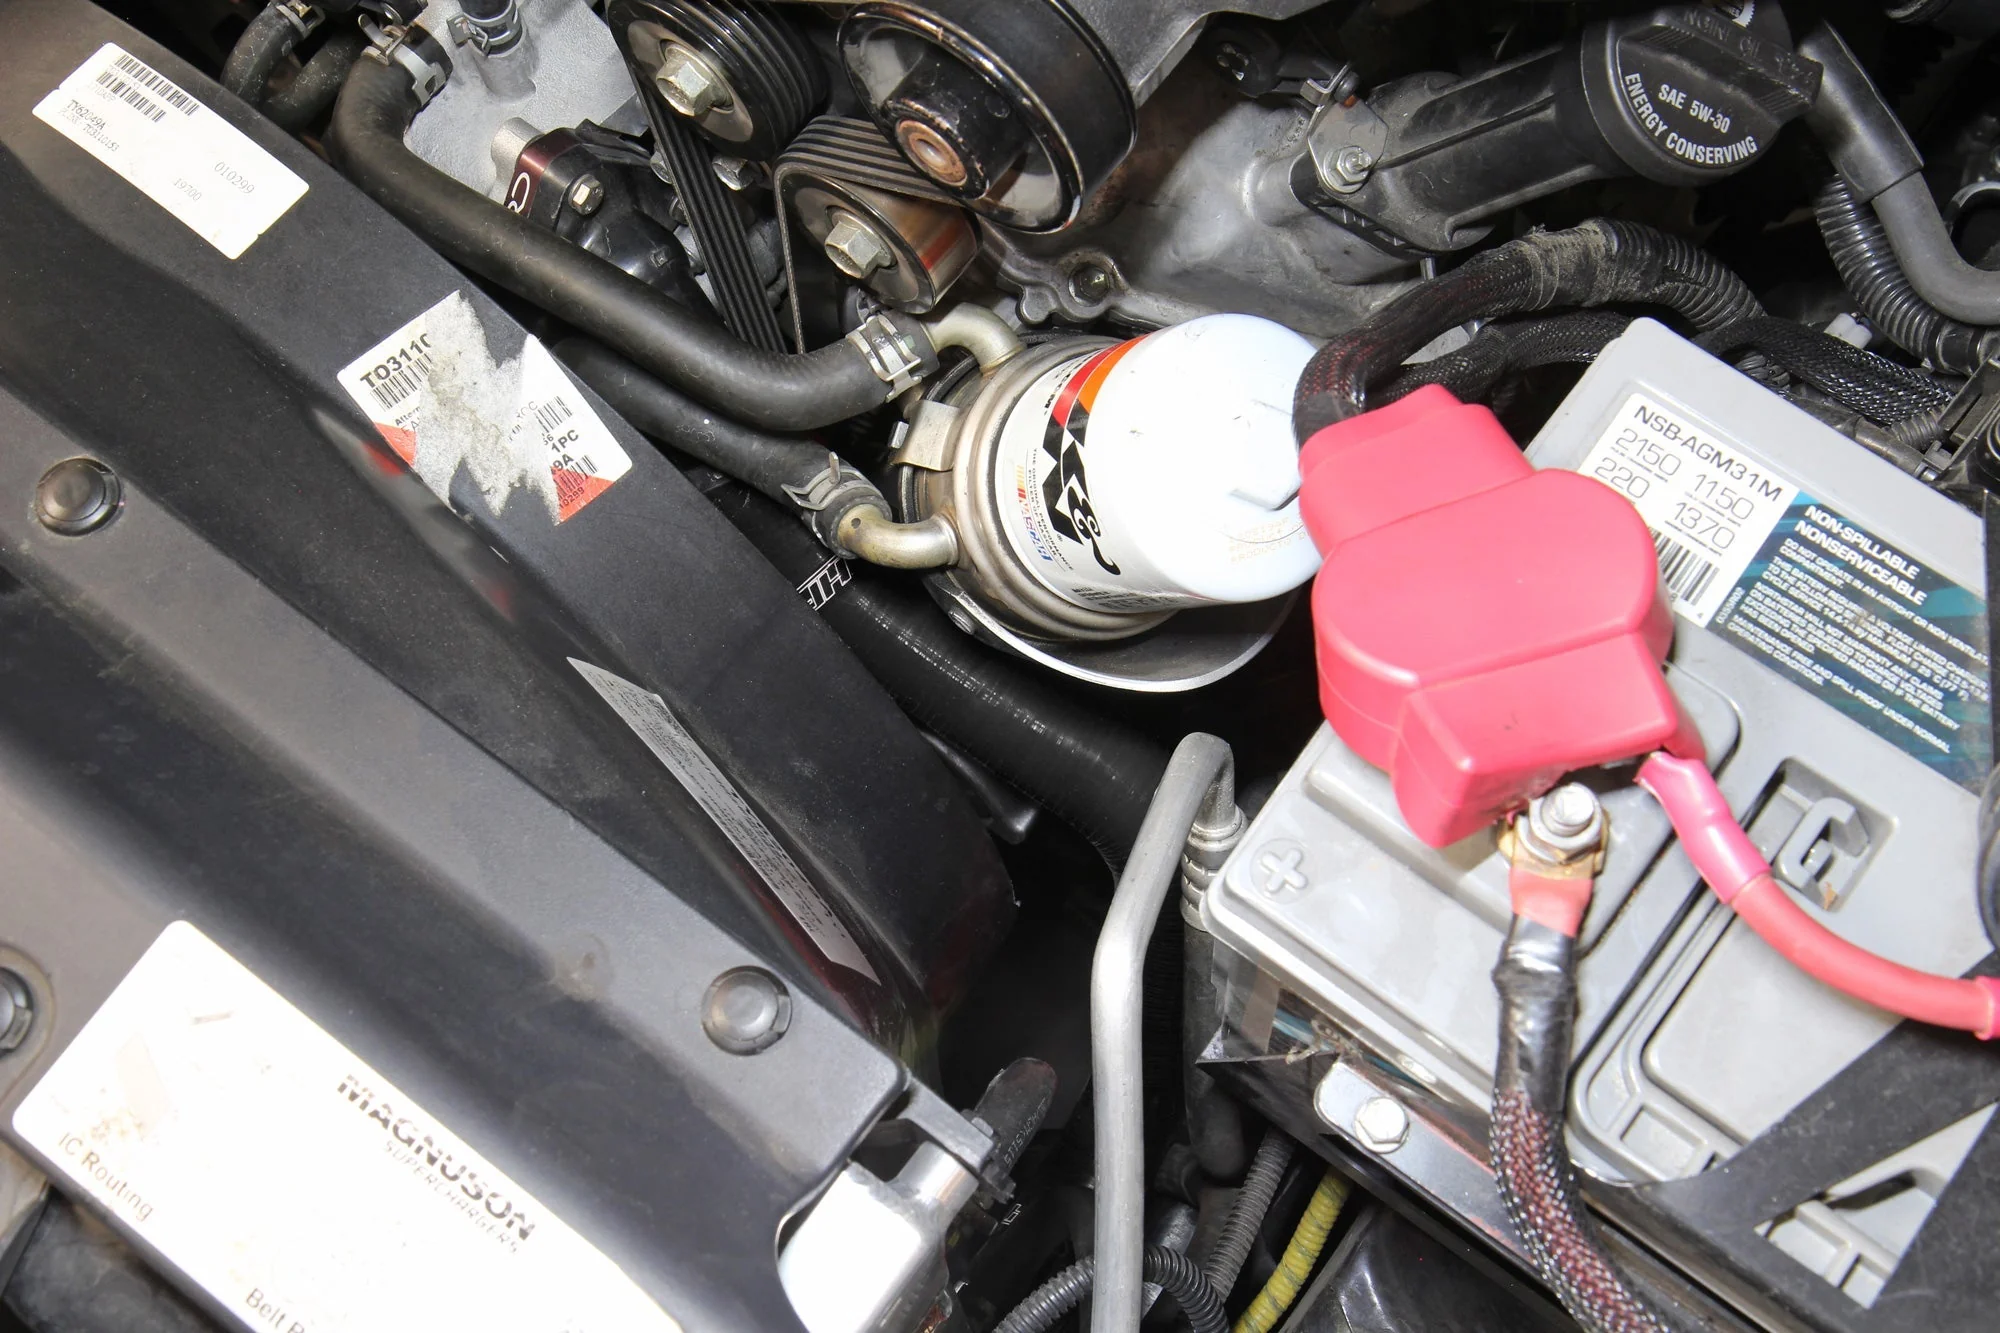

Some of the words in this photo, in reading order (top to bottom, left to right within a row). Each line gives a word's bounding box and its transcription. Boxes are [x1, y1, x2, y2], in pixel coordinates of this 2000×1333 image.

[1625, 72, 1668, 137] ENERGY
[1666, 132, 1757, 164] CONSERVING
[1658, 84, 1687, 110] SAE
[1690, 100, 1730, 134] 5W-30
[171, 176, 204, 202] 19700
[211, 160, 258, 196] 010299
[552, 429, 578, 452] 1PC
[1592, 455, 1651, 499] 220
[1613, 426, 1684, 477] 2150
[1630, 404, 1785, 502] NSB-AGM31M
[1667, 499, 1737, 551] 1370
[1687, 470, 1757, 521] 1150
[1038, 513, 1073, 571] PERFORMANCE
[1792, 519, 1928, 606] NONSERVICEABLE
[1802, 504, 1921, 580] NON-SPILLABLE
[1738, 602, 1759, 619] HAS
[1756, 613, 1782, 633] BEEN
[1760, 570, 1789, 591] CYCLE
[1787, 586, 1823, 611] SERVICE
[1865, 633, 1911, 665] MAXIMUM
[1766, 562, 1781, 575] TO
[1778, 570, 1797, 585] THE
[1794, 580, 1845, 614] FOLLOWING
[1885, 634, 1914, 656] FLOAT
[1912, 650, 1949, 677] CHARGE
[1771, 555, 1793, 572] THIS
[1790, 567, 1829, 594] BATTERY
[1874, 618, 1914, 646] VOLTAGE
[1911, 640, 1947, 666] LIMITED
[1783, 537, 1799, 550] DO
[1796, 545, 1817, 561] NOT
[1814, 555, 1854, 583] OPERATE
[1861, 584, 1878, 598] AN
[1875, 592, 1915, 620] AIRTIGHT
[1912, 614, 1928, 628] OR
[1925, 622, 1949, 641] NON
[1726, 620, 1774, 654] OPERATING
[1743, 595, 1792, 628] EXCEEDING
[1789, 623, 1808, 638] THE
[1805, 633, 1848, 664] SPECIFIED
[1846, 657, 1883, 685] RANGES
[1880, 678, 1896, 693] OR
[1902, 692, 1922, 709] THE
[1919, 703, 1960, 733] BATTERY
[1748, 588, 1765, 601] ON
[1762, 596, 1808, 628] BATTERIES
[1804, 622, 1855, 657] SUBJECTED
[1852, 650, 1867, 664] TO
[1864, 658, 1900, 685] CHARGE
[1898, 679, 1944, 711] VOLTAGES
[1753, 581, 1805, 616] NORTHSTAR
[1802, 610, 1826, 628] WILL
[1823, 623, 1844, 640] NOT
[1841, 634, 1892, 669] WARRANTY
[1889, 663, 1911, 681] ANY
[1908, 674, 1944, 701] CLAIMS
[1731, 613, 1793, 655] MAINTENANCE
[1790, 649, 1814, 668] FREE
[1811, 662, 1833, 680] AND
[1830, 674, 1856, 694] SPILL
[1852, 687, 1885, 712] PROOF
[1881, 705, 1915, 731] UNDER
[1912, 723, 1952, 754] NORMAL
[56, 1129, 85, 1157] IC
[75, 1149, 158, 1223] Routing
[334, 1072, 539, 1241] MAGNUSON
[246, 1287, 286, 1329] Belt
